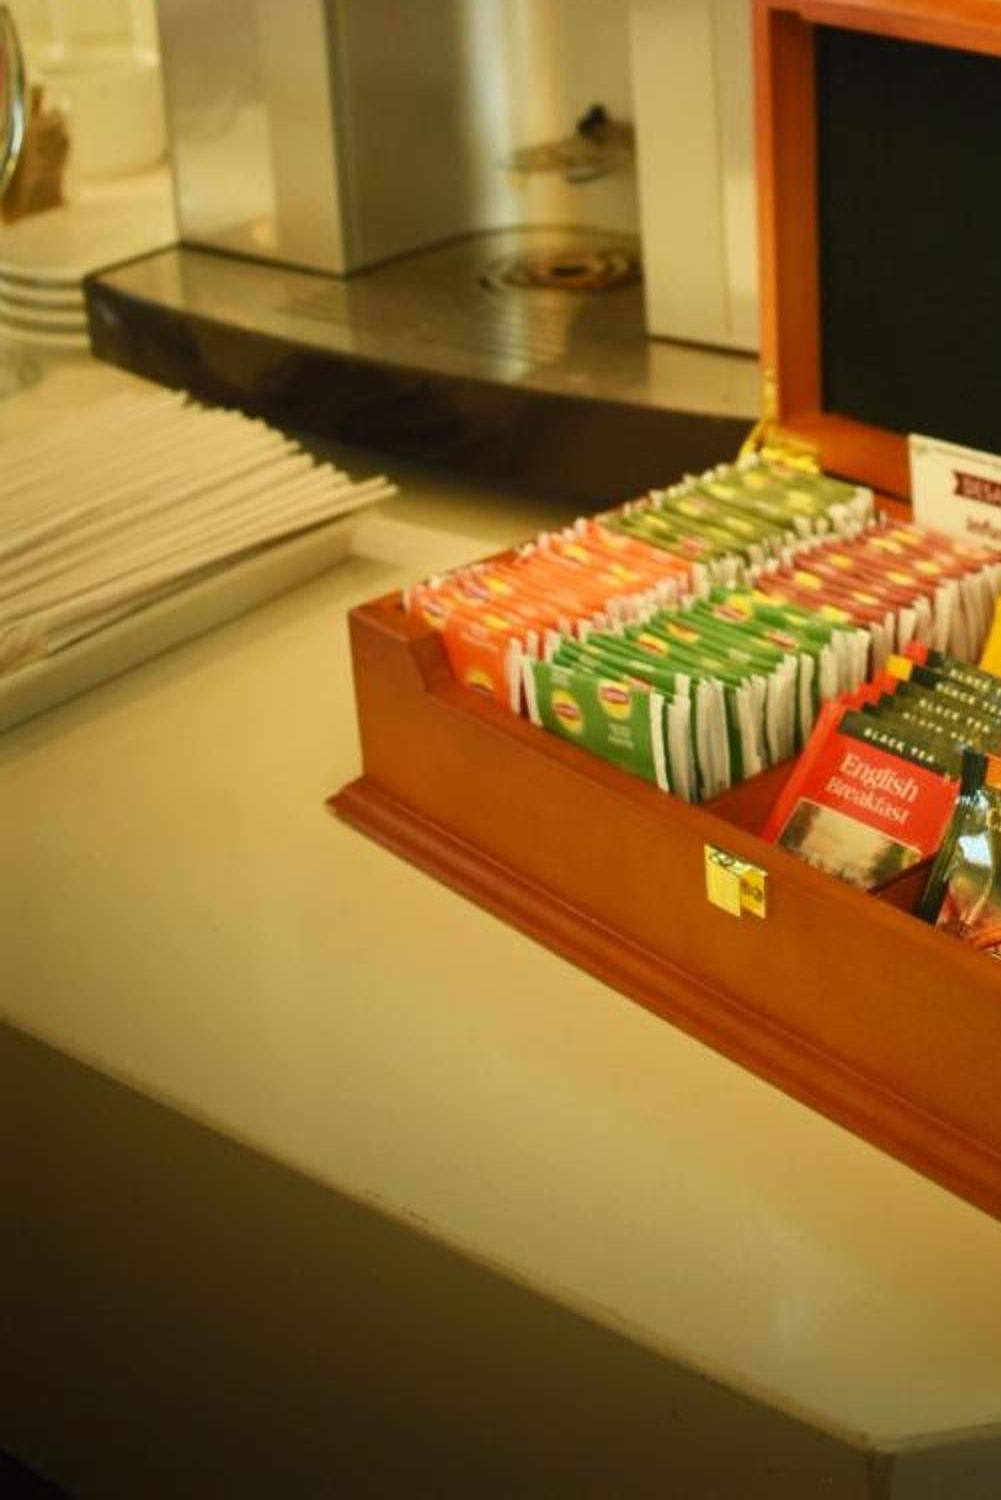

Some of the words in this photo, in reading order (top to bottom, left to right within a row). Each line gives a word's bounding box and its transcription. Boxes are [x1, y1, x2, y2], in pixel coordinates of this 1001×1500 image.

[935, 681, 975, 705] BLACK
[950, 668, 991, 690] BLACK
[918, 698, 961, 721] BLACK
[966, 716, 991, 733] TEA
[863, 727, 905, 752] BLACK
[910, 745, 935, 764] TEA
[839, 753, 920, 803] English
[825, 776, 910, 825] Breakfast
